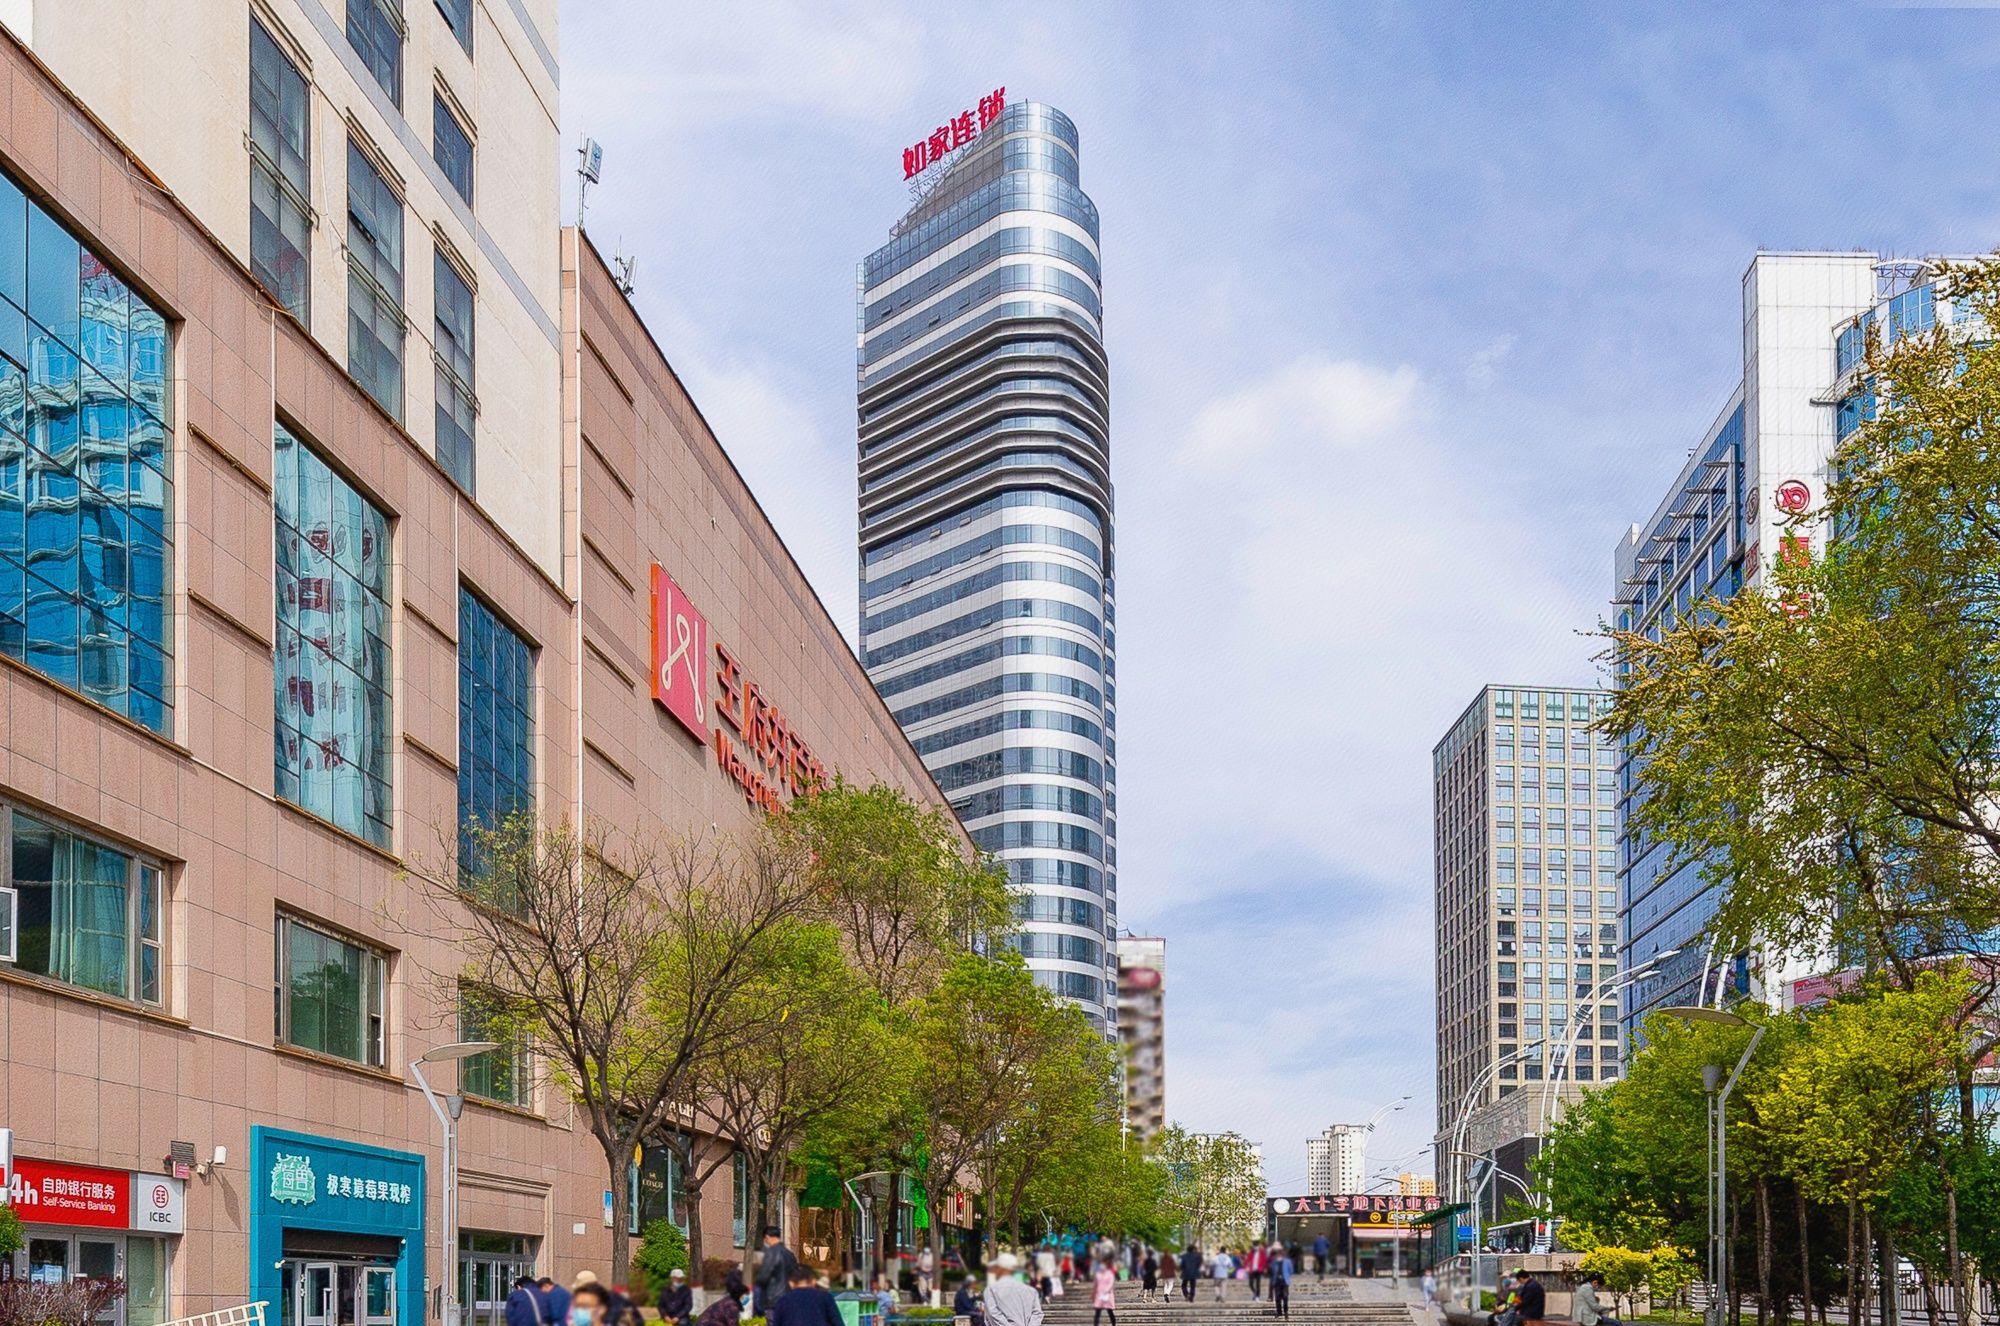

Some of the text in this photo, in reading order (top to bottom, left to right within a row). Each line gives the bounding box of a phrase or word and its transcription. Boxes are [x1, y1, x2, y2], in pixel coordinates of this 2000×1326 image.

[902, 86, 1005, 181] 如家连锁
[9, 1173, 38, 1205] 4h
[42, 1177, 115, 1200] 自助银行服务
[42, 1196, 116, 1214] Self-Service Banking
[149, 1211, 171, 1223] ICBC
